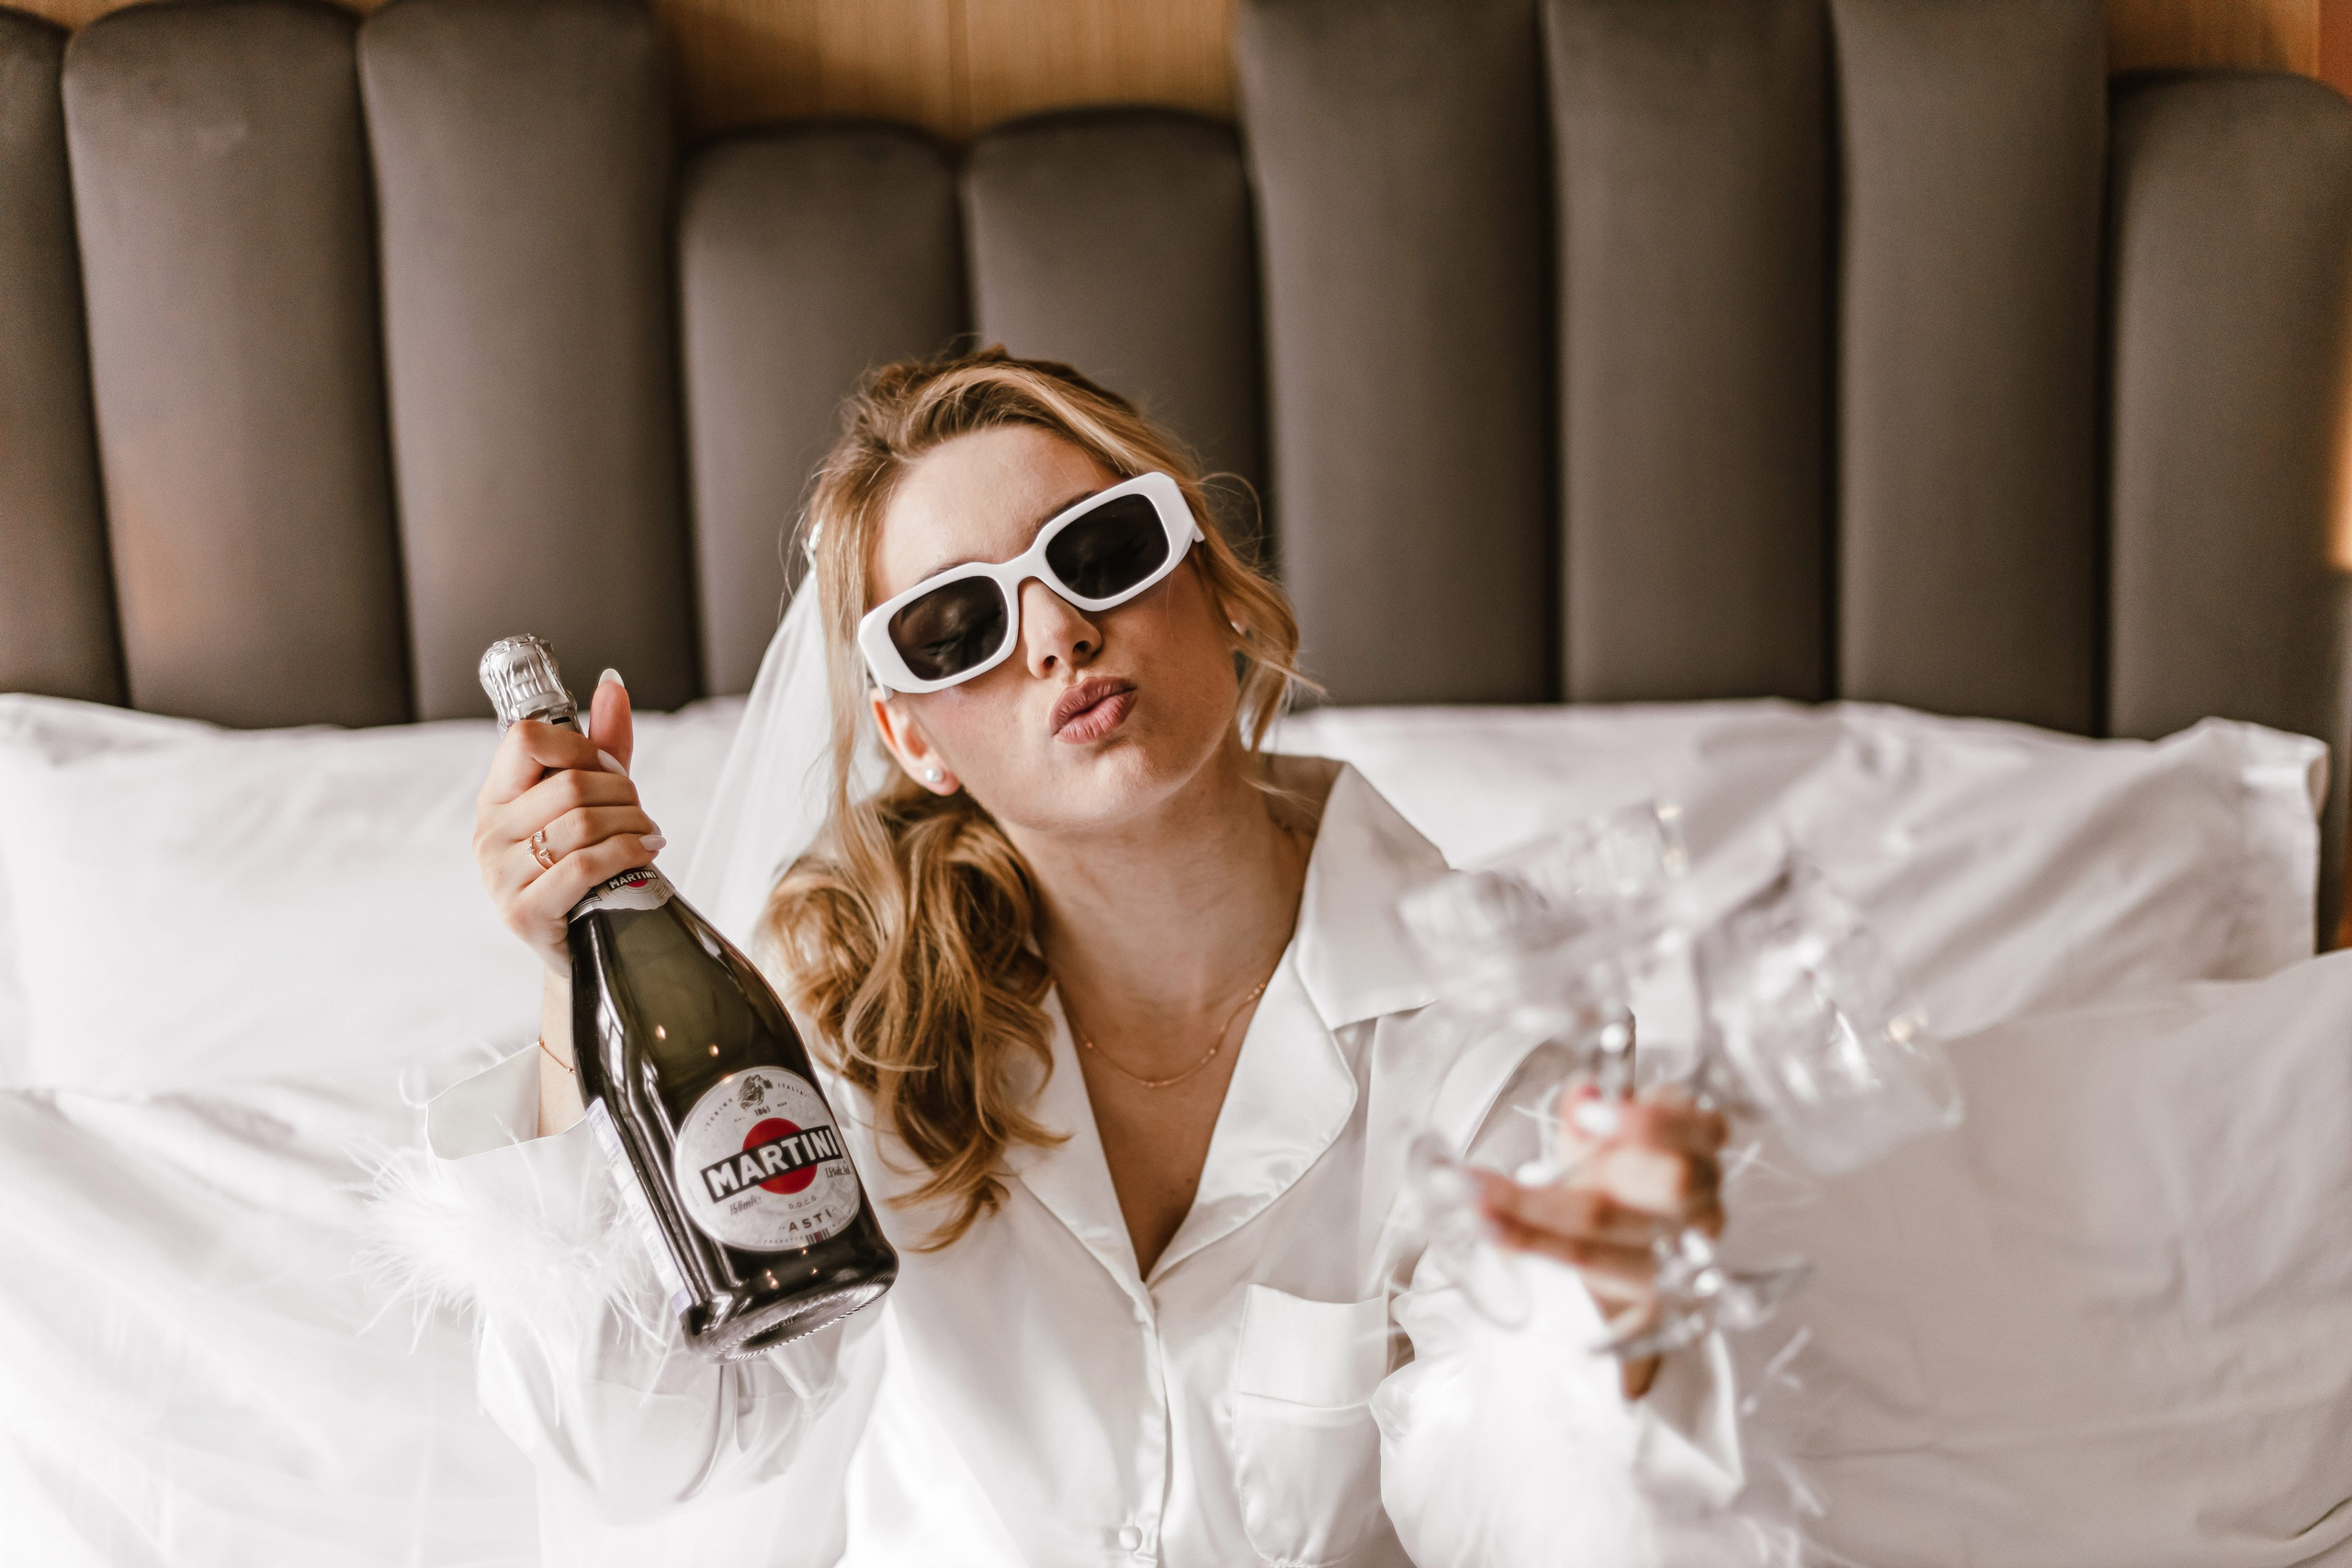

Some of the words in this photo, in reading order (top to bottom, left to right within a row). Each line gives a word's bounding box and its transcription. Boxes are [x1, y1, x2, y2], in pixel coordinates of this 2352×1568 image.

[609, 871, 657, 889] MARTINI
[754, 1105, 771, 1117] 1863
[706, 1129, 839, 1199] MARTINI
[788, 1209, 832, 1232] ASTI
